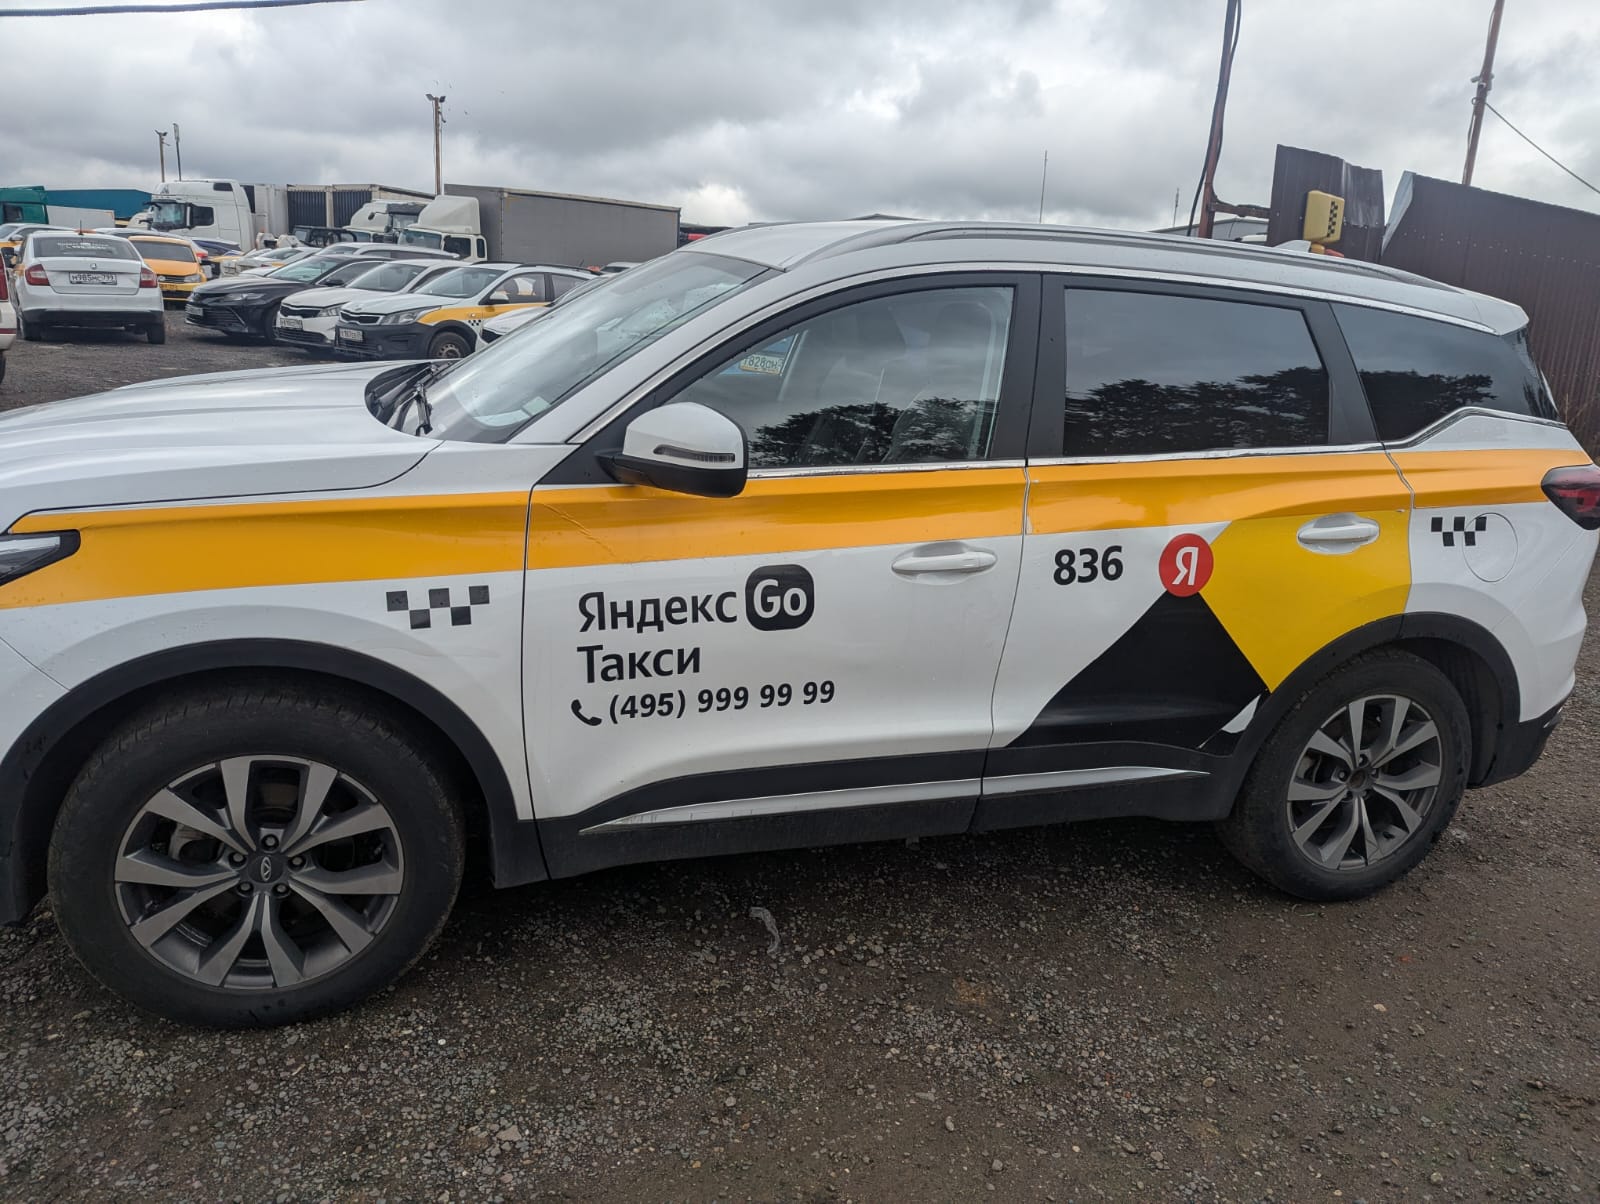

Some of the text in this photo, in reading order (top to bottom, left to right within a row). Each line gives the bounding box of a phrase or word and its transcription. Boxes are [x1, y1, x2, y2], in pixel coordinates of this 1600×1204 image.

[1053, 545, 1124, 586] 836
[1171, 546, 1200, 586] Я
[578, 578, 807, 634] Яндекс Go
[576, 644, 701, 684] Такси
[609, 680, 835, 725] (495) 999 99 99
